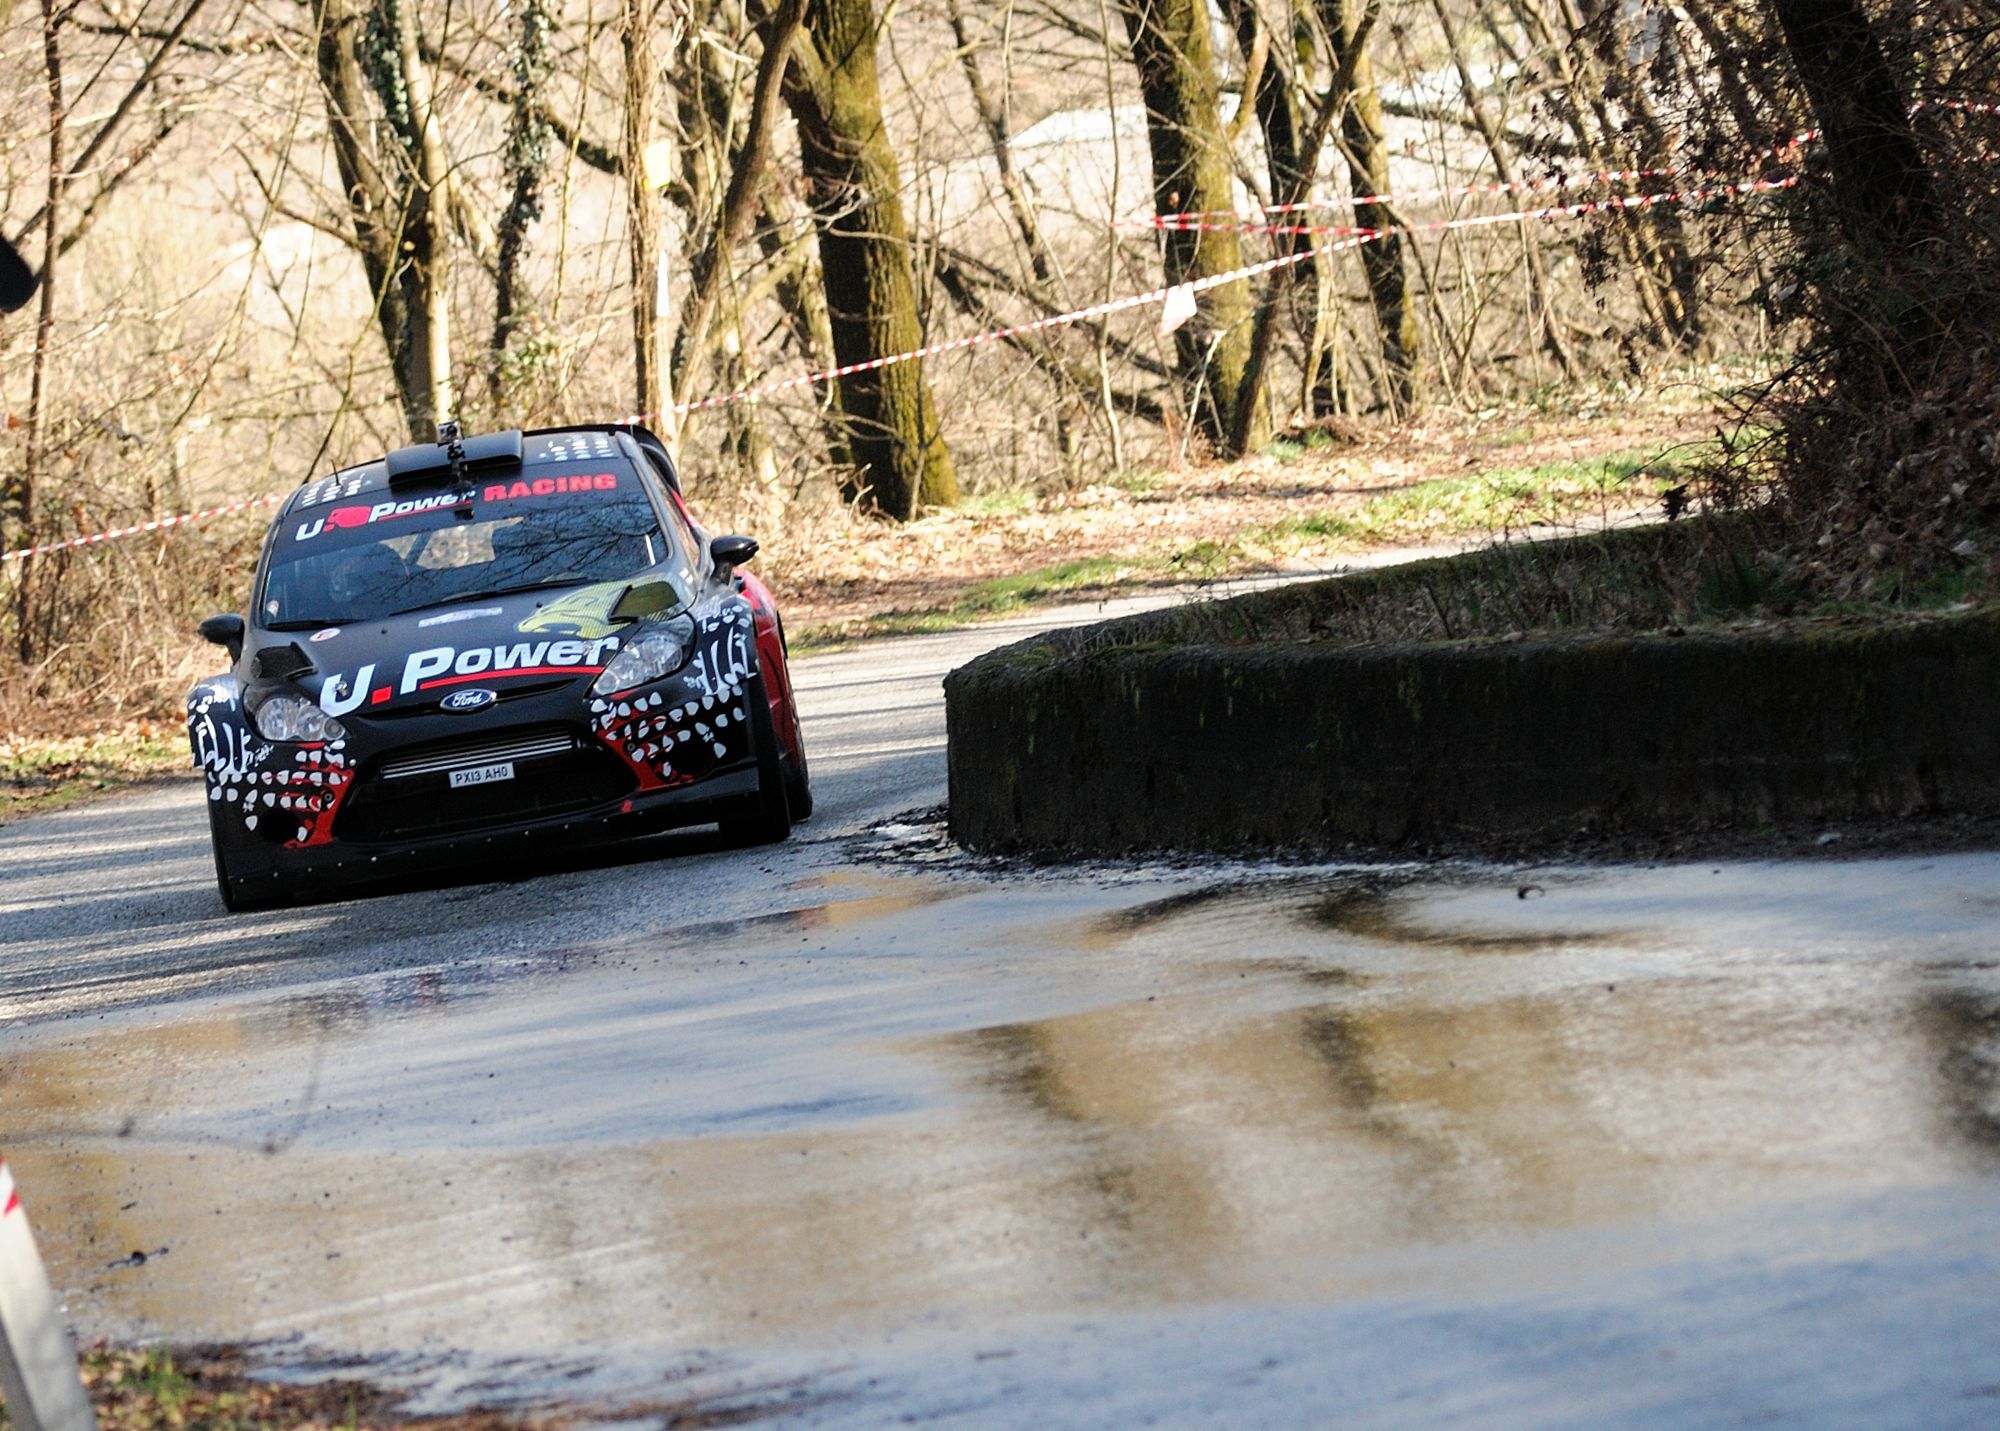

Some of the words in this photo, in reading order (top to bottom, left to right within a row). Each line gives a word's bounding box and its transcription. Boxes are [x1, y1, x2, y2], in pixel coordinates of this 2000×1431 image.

[484, 473, 617, 501] RACING
[452, 692, 482, 707] Ford
[455, 773, 482, 784] PX13
